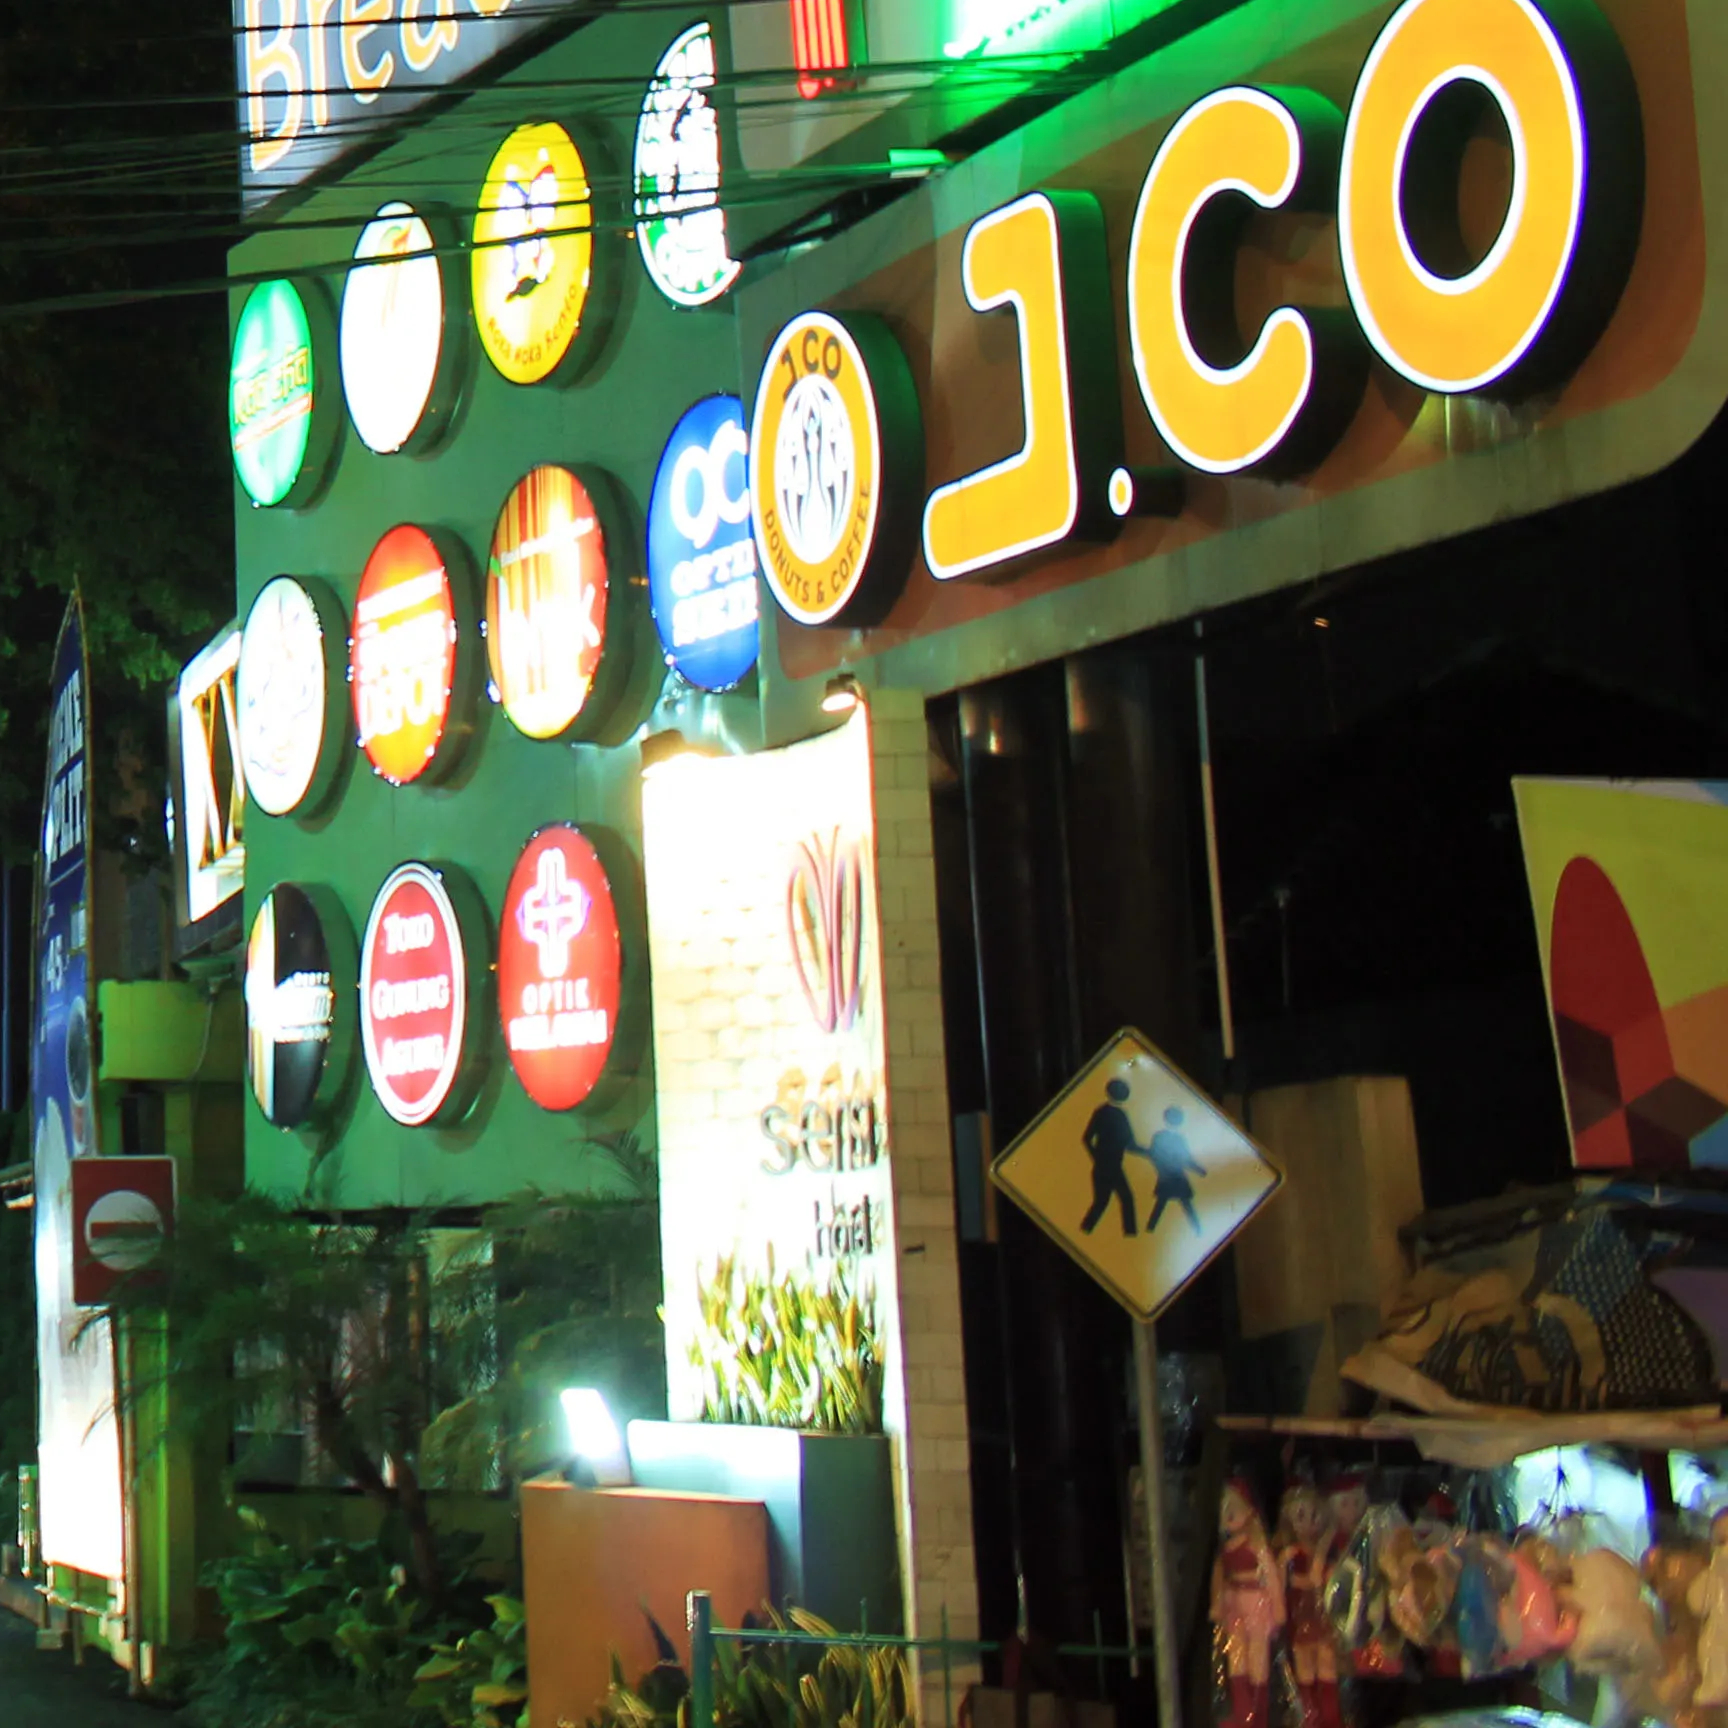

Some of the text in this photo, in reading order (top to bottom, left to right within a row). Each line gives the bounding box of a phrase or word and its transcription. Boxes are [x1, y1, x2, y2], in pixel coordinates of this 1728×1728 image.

[764, 478, 871, 605] DONUTS & COFFEE
[523, 977, 590, 1015] OPTIK
